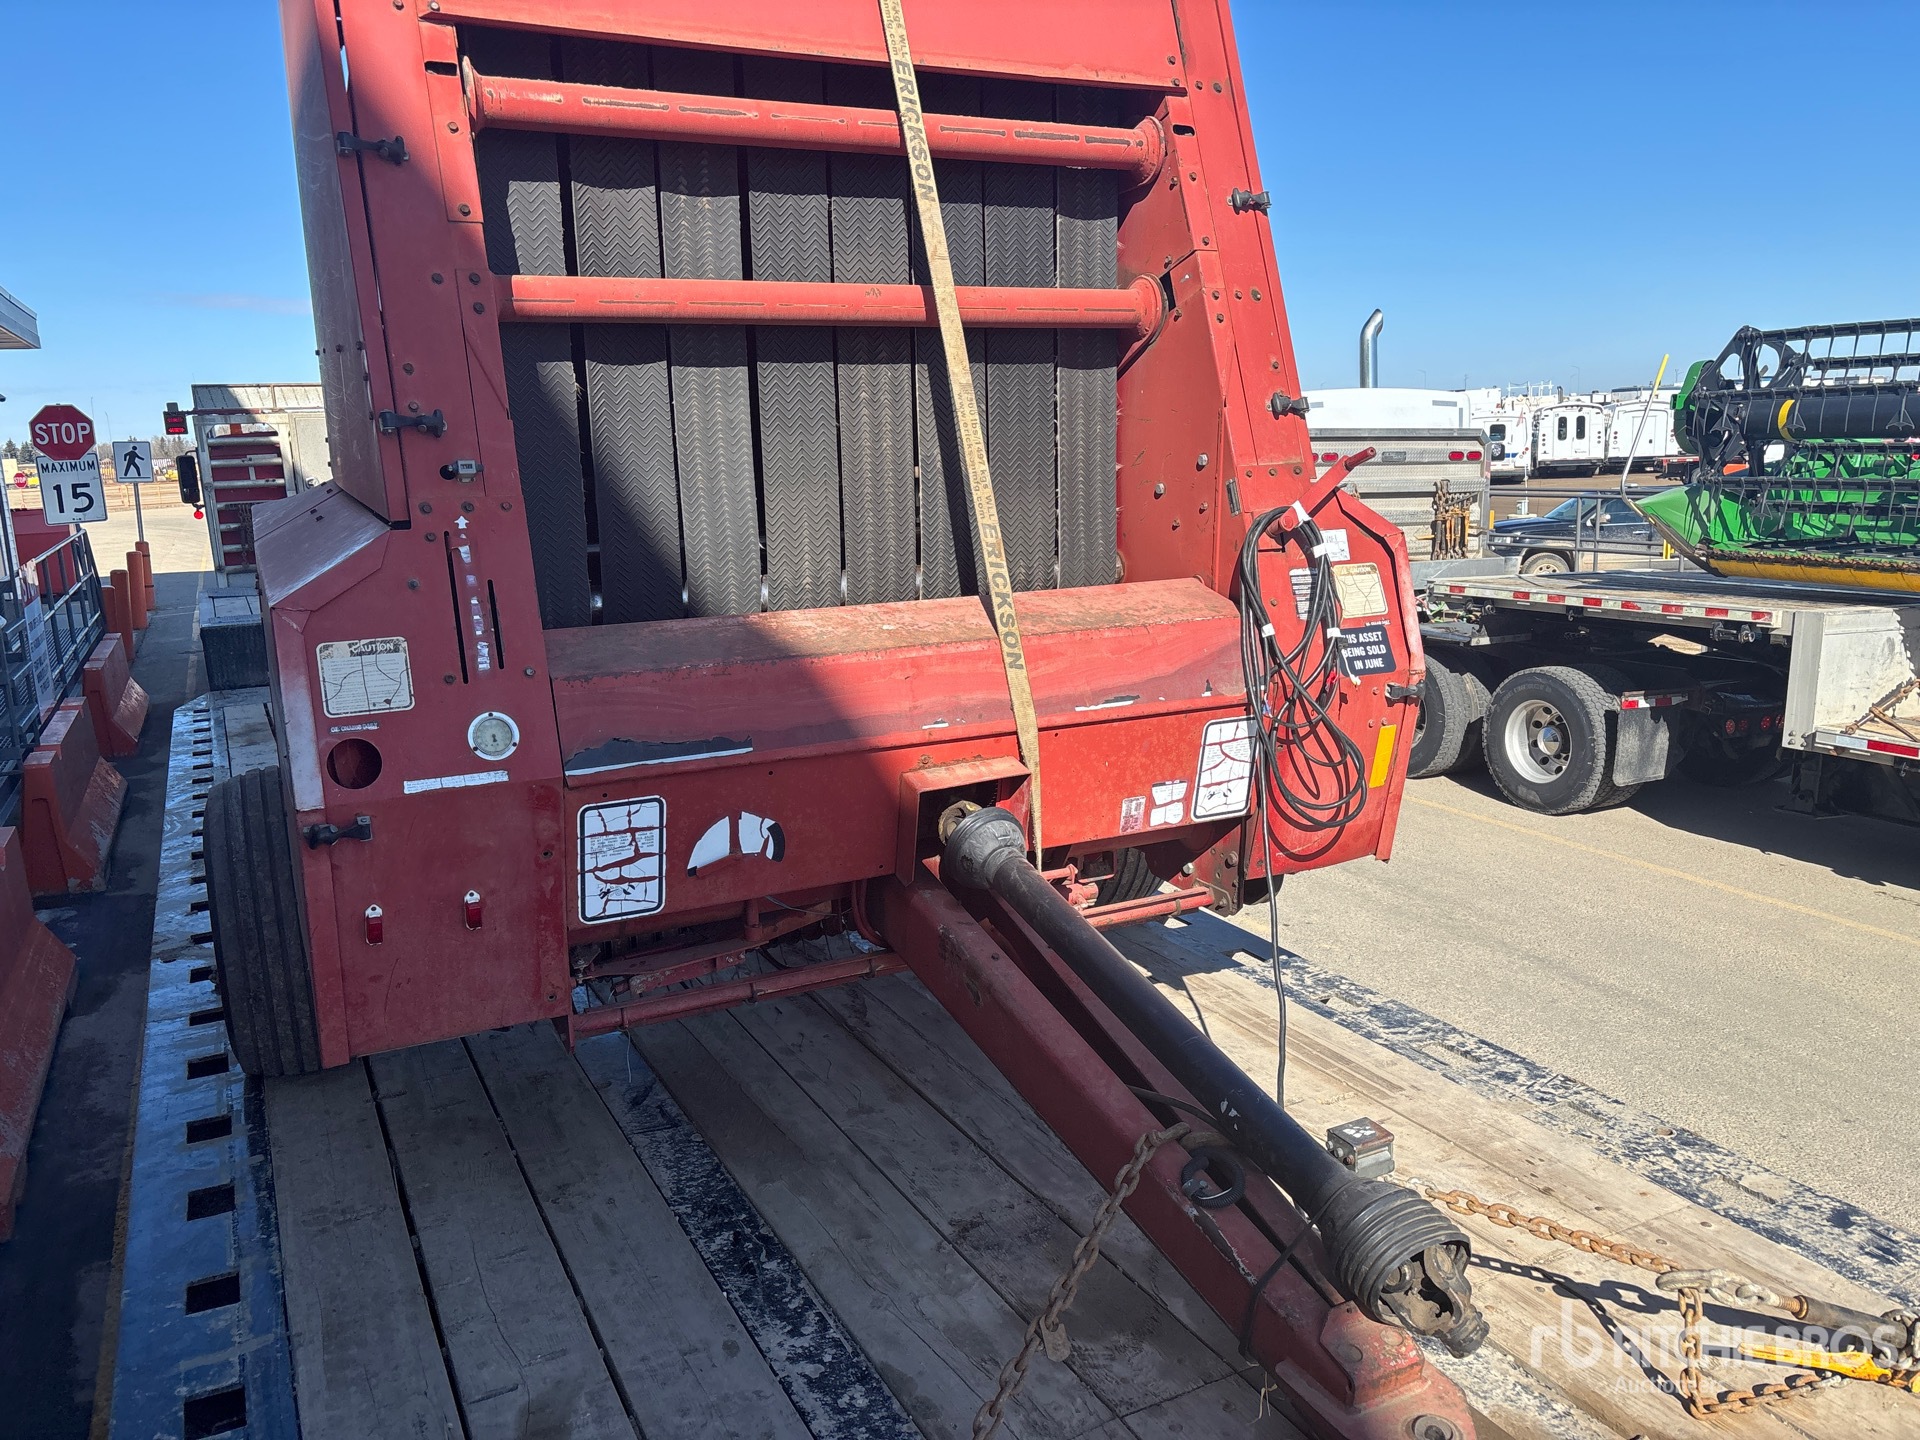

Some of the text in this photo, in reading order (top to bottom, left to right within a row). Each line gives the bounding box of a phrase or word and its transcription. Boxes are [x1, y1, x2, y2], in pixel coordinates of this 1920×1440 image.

[883, 0, 898, 56] nmfg.com
[898, 34, 908, 58] WLL
[894, 59, 936, 203] ERICKSON
[34, 422, 91, 445] STOP
[41, 460, 96, 474] MAXIMUM
[52, 482, 95, 514] 15
[979, 469, 989, 490] kgs
[985, 494, 995, 521] WLL
[980, 522, 1024, 671] ERICKSON
[351, 643, 394, 654] CAUTION
[1359, 631, 1383, 643] ASSET
[1342, 644, 1387, 658] BEING SOLD
[1353, 658, 1385, 670] IN JUNE
